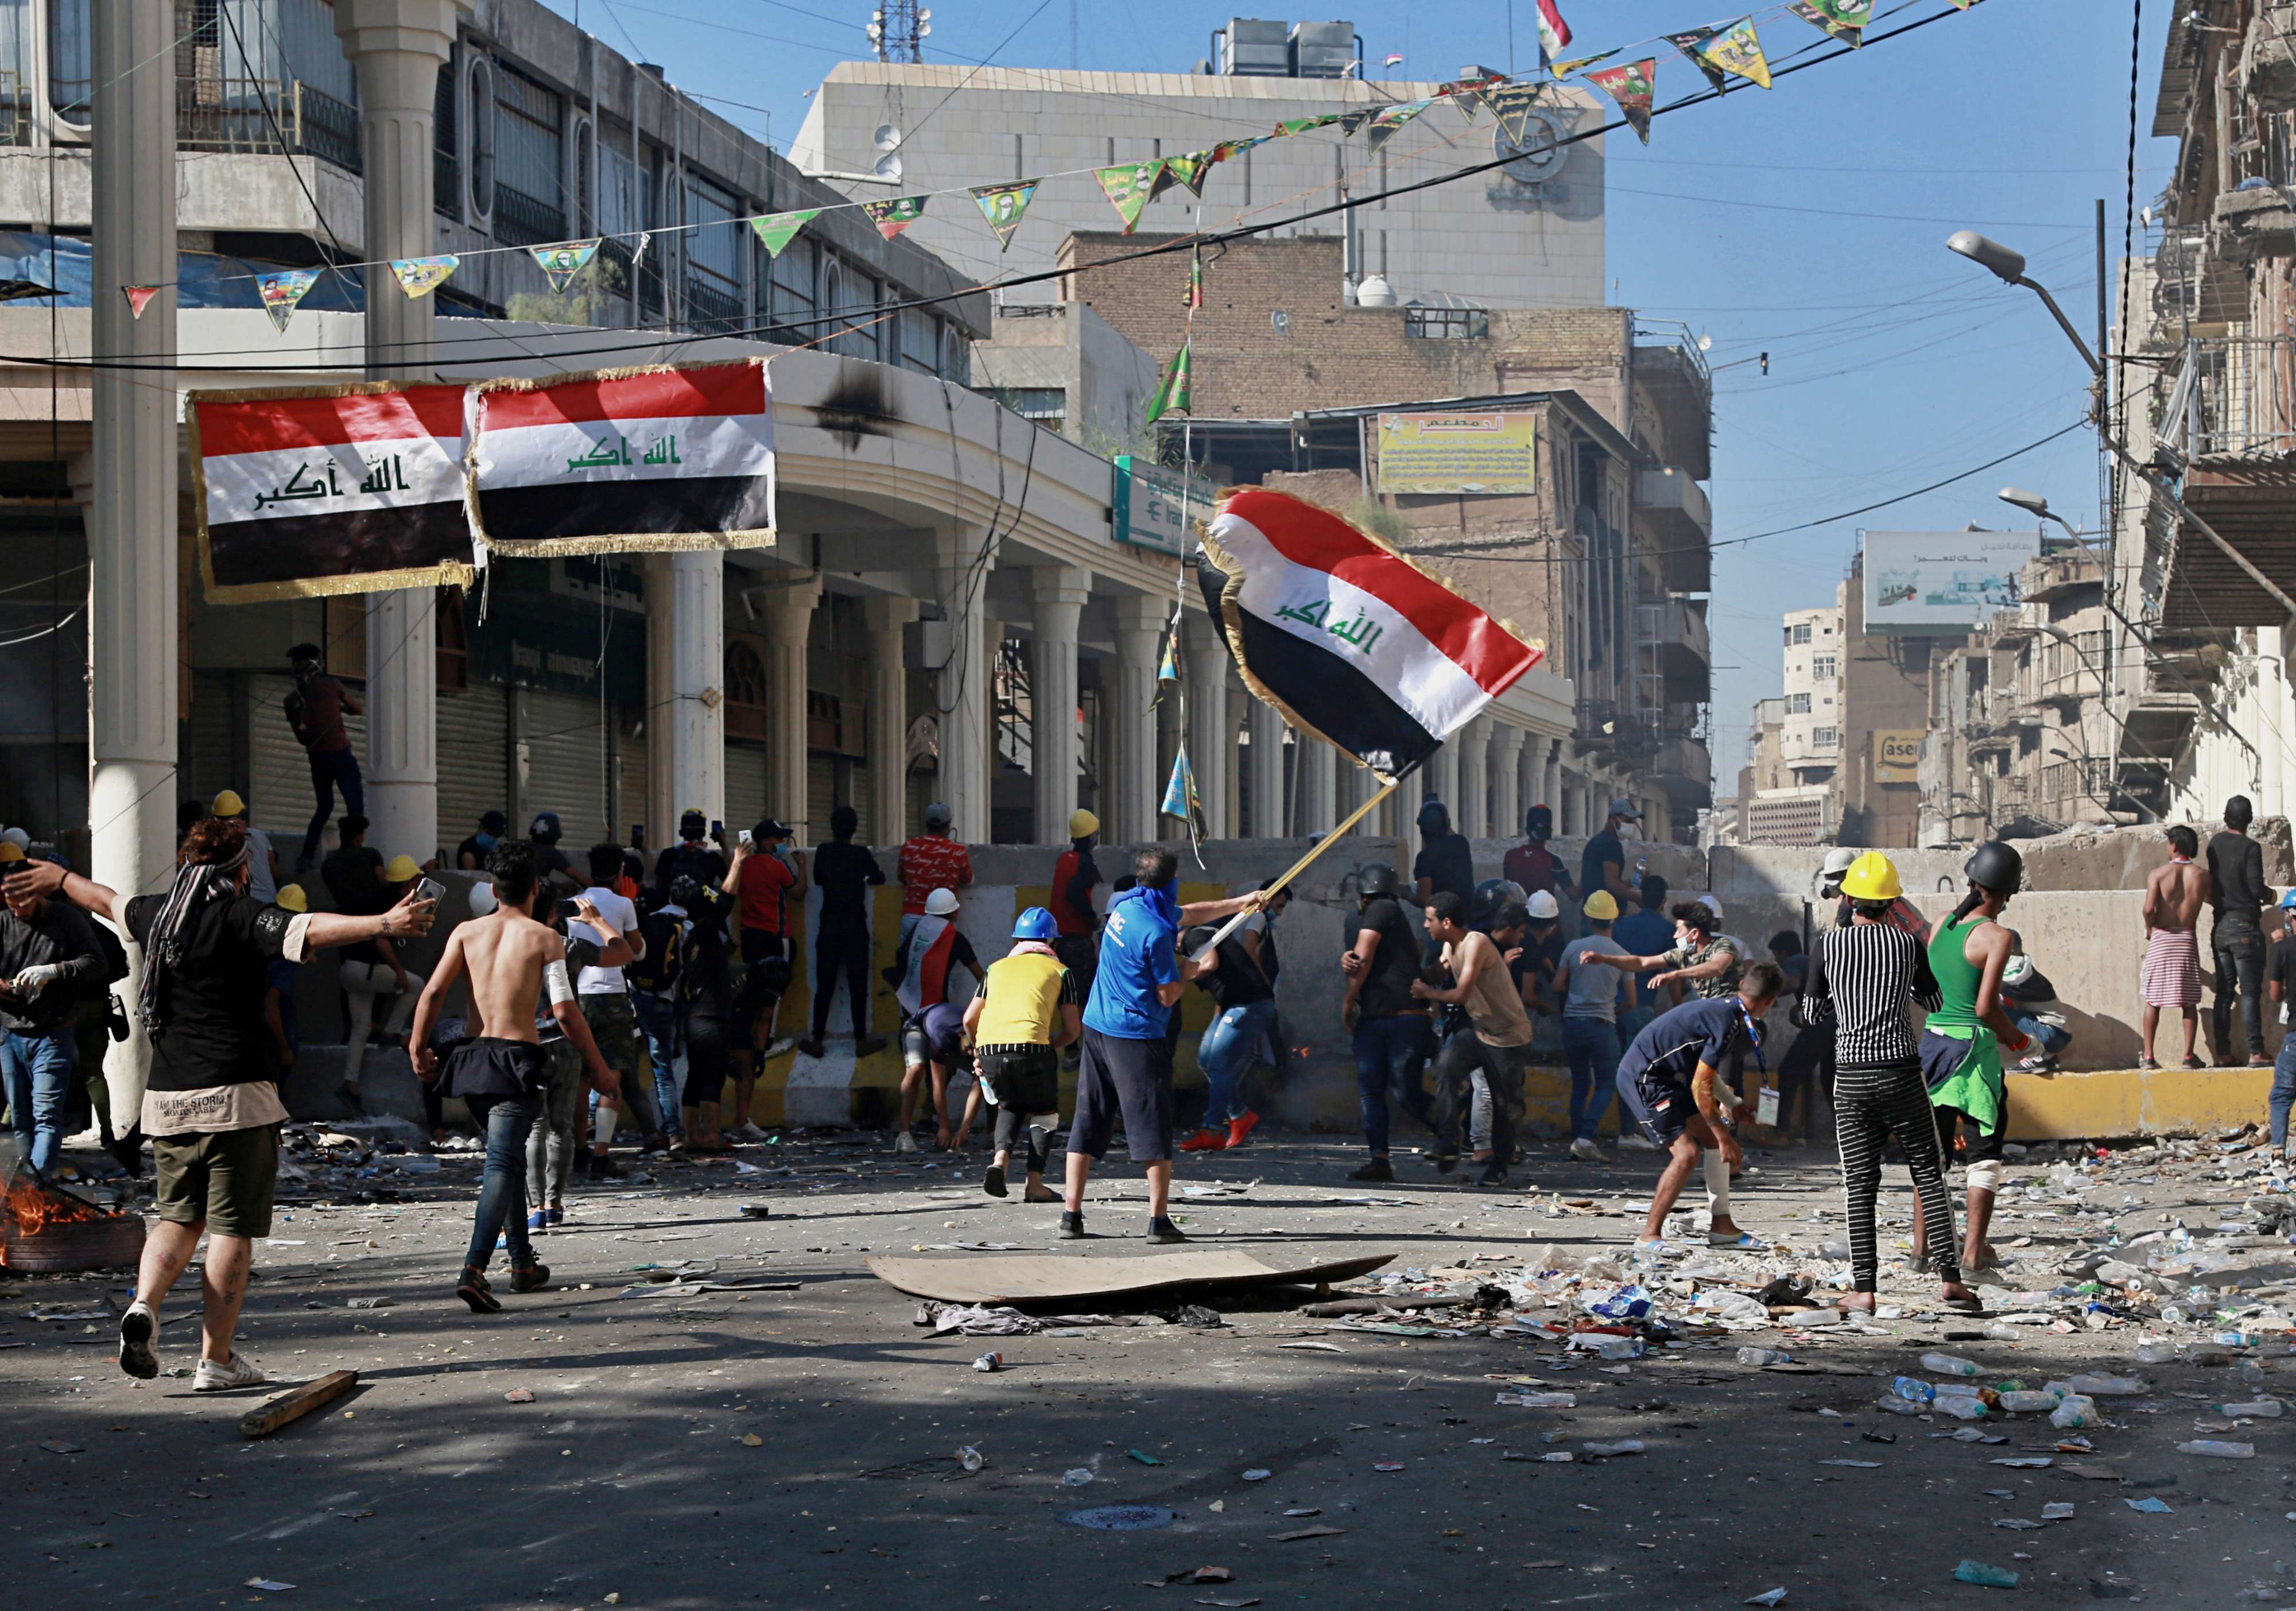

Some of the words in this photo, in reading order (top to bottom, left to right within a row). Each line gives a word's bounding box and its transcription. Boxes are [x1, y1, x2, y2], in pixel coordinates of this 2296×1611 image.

[1428, 419, 1479, 428] مطعم
[641, 433, 682, 466] الله
[360, 454, 410, 494] الله
[1330, 606, 1383, 654] الله
[171, 1098, 188, 1109] THE
